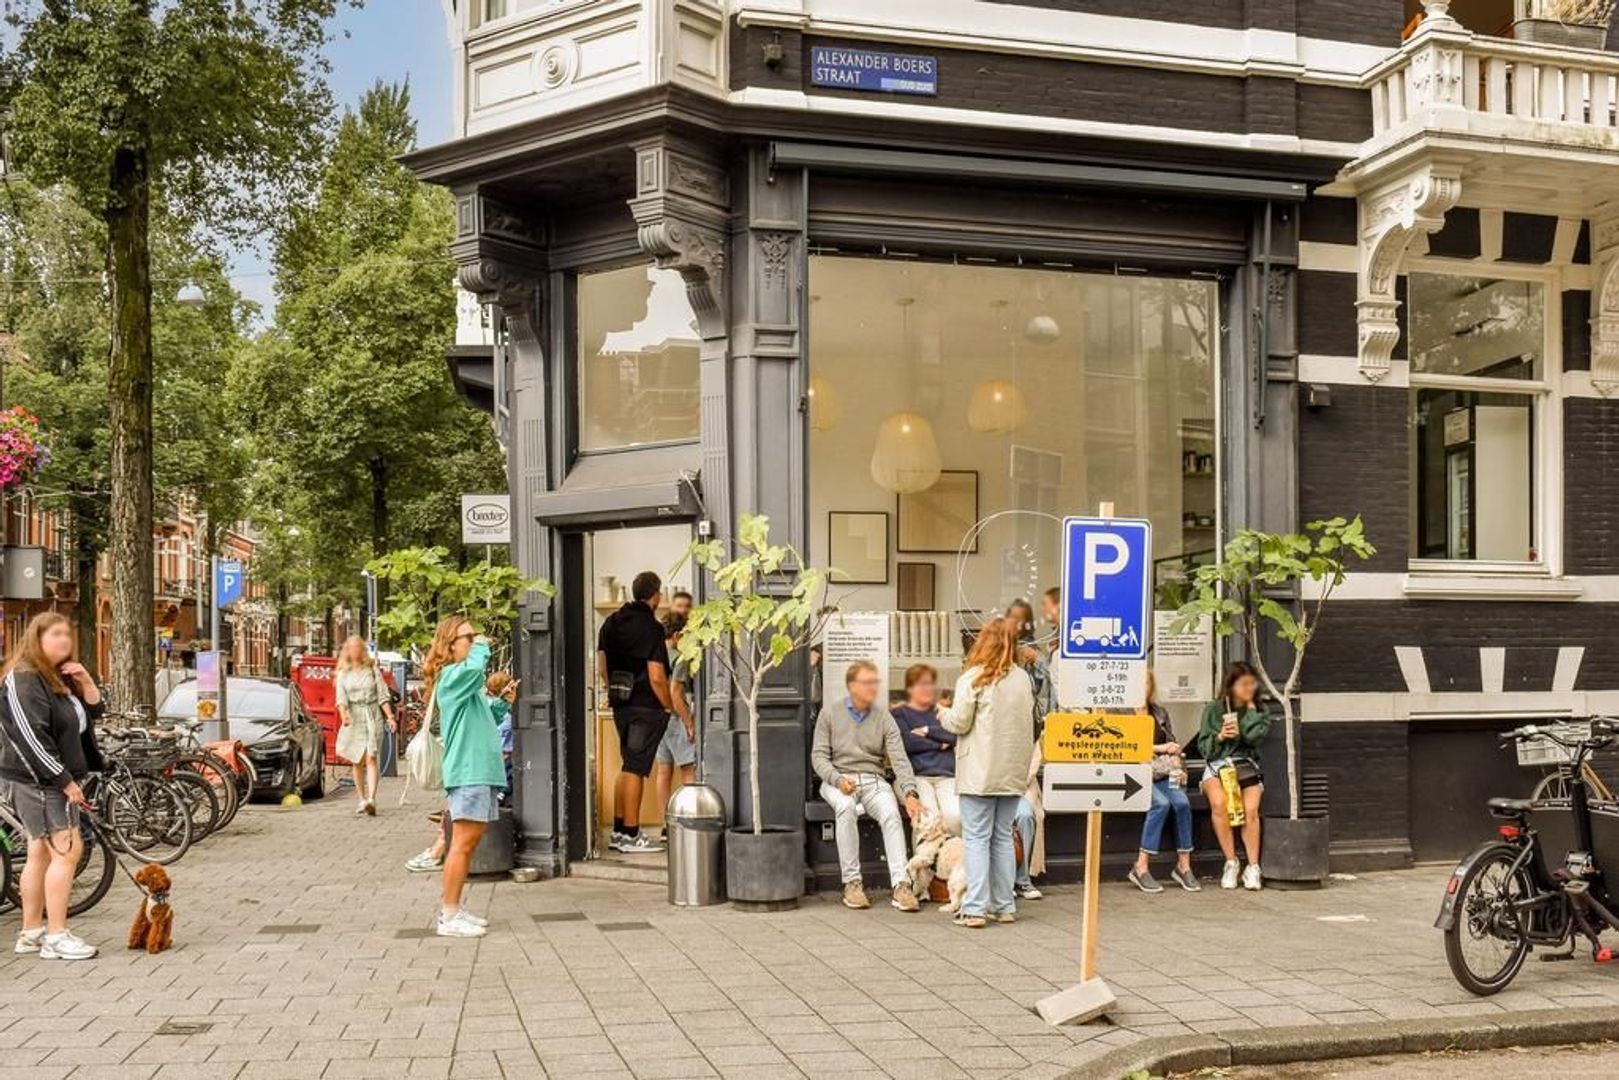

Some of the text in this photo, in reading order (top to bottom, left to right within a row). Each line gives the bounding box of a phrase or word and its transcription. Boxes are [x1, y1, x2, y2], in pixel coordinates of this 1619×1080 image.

[817, 51, 932, 74] ALEXANDER BOERS
[816, 67, 861, 84] STRAAT
[472, 508, 505, 521] baxter
[1083, 532, 1129, 599] P
[224, 575, 235, 593] P
[1086, 662, 1097, 671] op
[1087, 686, 1097, 695] op
[1058, 740, 1138, 752] wegsleepregeling
[1072, 752, 1089, 760] van
